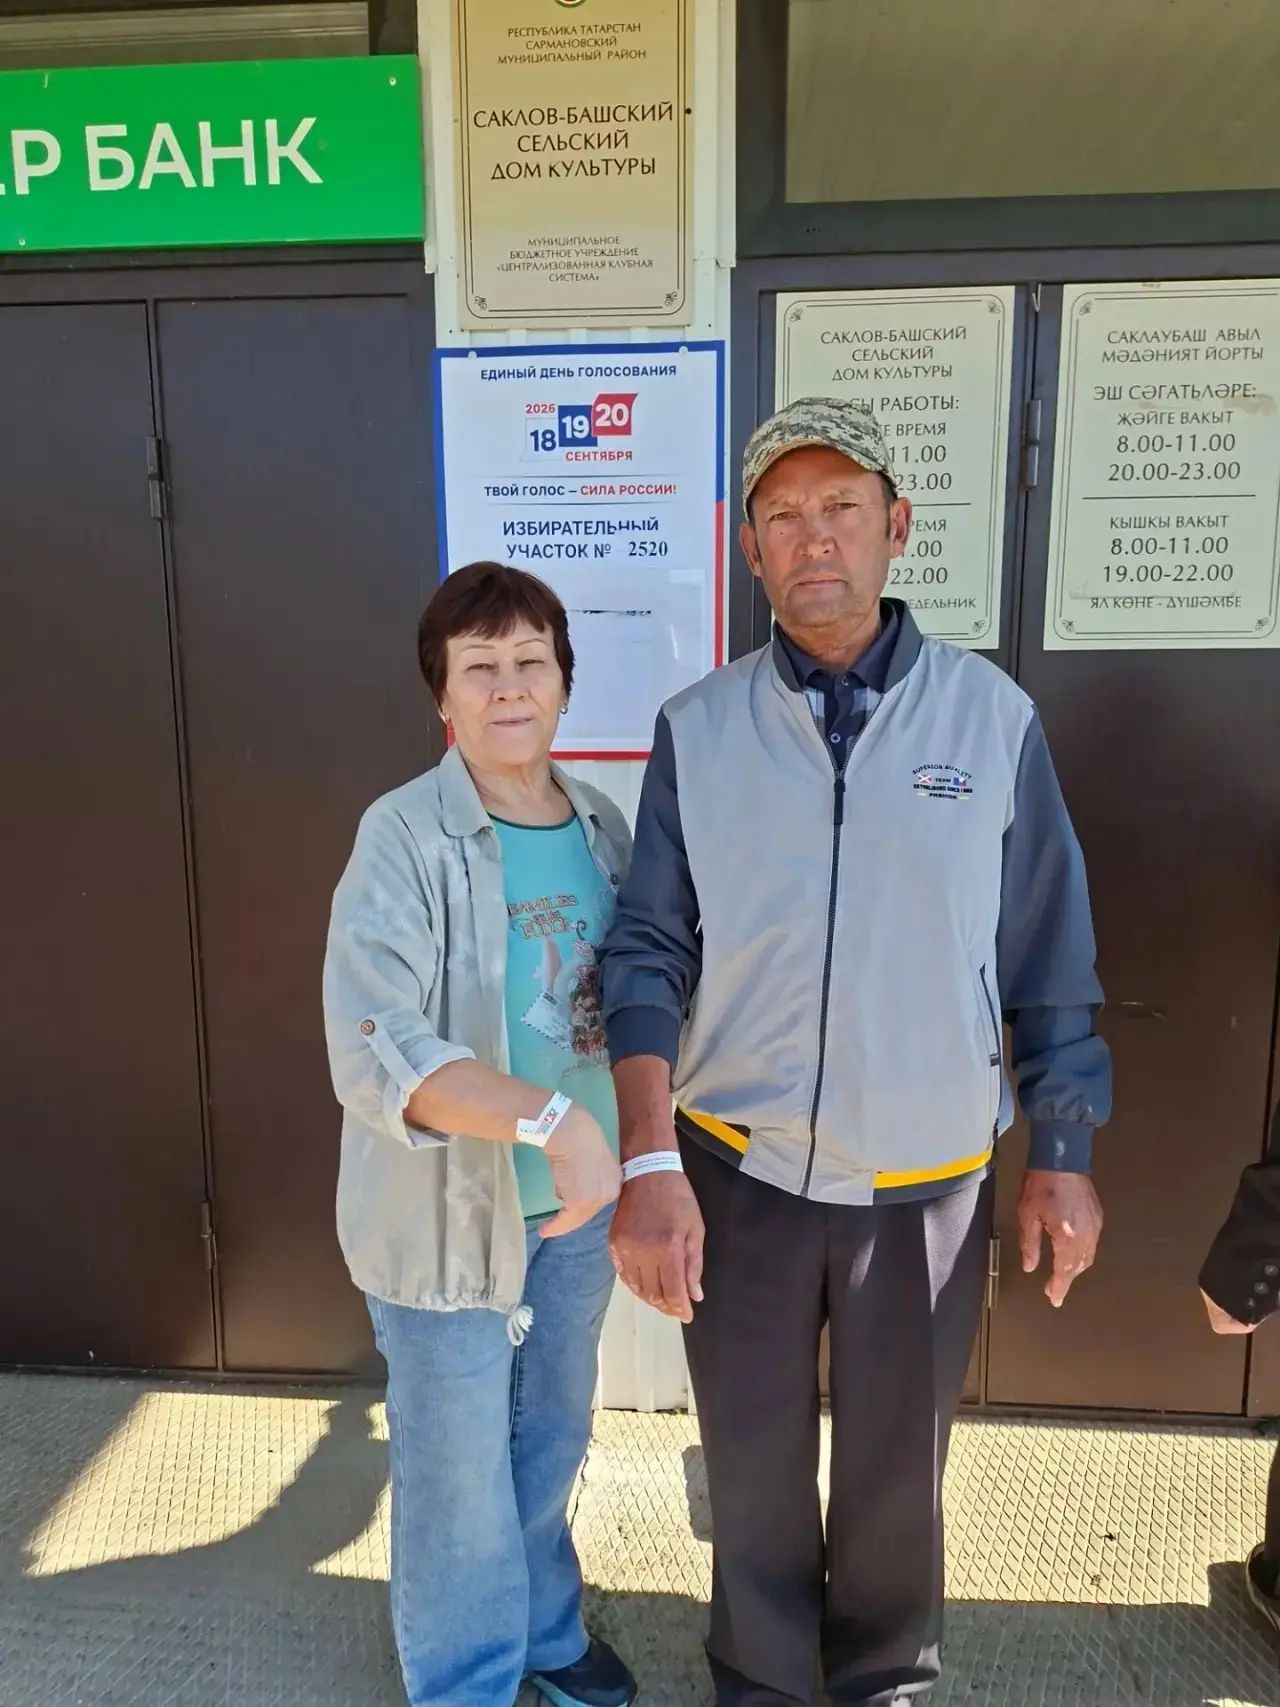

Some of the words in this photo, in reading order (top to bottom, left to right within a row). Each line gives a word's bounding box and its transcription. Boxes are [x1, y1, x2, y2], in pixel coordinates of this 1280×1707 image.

[507, 26, 577, 38] РЕСПУБЛИКА
[580, 23, 641, 34] ТАТАРСТАН
[525, 36, 617, 50] САРМАНОВСКИЙ
[498, 51, 601, 64] МУНИЦИПАЛЬНЫЙ
[607, 49, 646, 60] РАЙОН
[473, 101, 673, 128] САКЛОВ-БАШСКИЙ
[517, 129, 629, 153] СЕЛЬСКИЙ
[0, 129, 62, 195] Р
[85, 117, 324, 192] БАНК
[491, 161, 541, 180] ДОМ
[548, 157, 656, 177] КУЛЬТУРЫ
[528, 236, 620, 247] МУНИЦИПАЛЬНОЕ
[509, 249, 572, 259] БЮДЖЕТНОЕ
[575, 247, 639, 258] УЧРЕЖДЕНИЕ
[497, 260, 605, 272] «ЦЕНТРАЛИЗОВАННАЯ
[608, 259, 653, 269] КЛУБНАЯ
[548, 273, 600, 282] СИСТЕМА»
[820, 326, 967, 345] САКЛОВ-БАШСКИЙ
[1107, 329, 1207, 344] САКЛАУБАШ
[1215, 328, 1261, 341] АВЫЛ
[852, 345, 933, 362] СЕЛЬСКИЙ
[1102, 348, 1200, 364] МӘДӘНИЯТ
[1205, 346, 1263, 361] ЙОРТЫ
[480, 366, 536, 381] ЕДИНЫЙ
[540, 367, 574, 379] ДЕНЬ
[578, 365, 677, 377] ГОЛОСОВАНИЯ
[832, 368, 869, 382] ДОМ
[874, 365, 953, 380] КУЛЬТУРЫ
[1094, 385, 1123, 401] ЭШ
[1129, 383, 1257, 400] СӘГАТЬЛӘРЕ:
[525, 403, 556, 414] 2026
[881, 395, 960, 412] РАБОТЫ:
[595, 403, 629, 427] 20
[1180, 411, 1234, 425] ВАКЫТ
[561, 415, 590, 439] 19
[896, 422, 946, 437] ВРЕМЯ
[530, 429, 557, 452] 18
[1117, 433, 1236, 453] 8.00-11.00
[565, 451, 633, 462] СЕНТЯБРЯ
[889, 445, 947, 463] 11.00
[1108, 461, 1241, 481] 20.00-23.00
[895, 472, 952, 491] 23.00
[484, 484, 519, 497] ТВОЙ
[522, 485, 565, 496] ГОЛОС
[580, 484, 615, 496] СИЛА
[619, 484, 677, 495] РОССИИ!
[503, 516, 660, 536] ИЗБИРАТЕЛЬНЫЙ
[911, 519, 947, 532] ЕМЯ
[1110, 516, 1170, 529] КЫШКЫ
[1175, 515, 1230, 528] ВАКЫТ
[507, 544, 589, 559] УЧАСТОК
[594, 544, 611, 558] №
[628, 541, 668, 557] 2520
[1111, 536, 1229, 555] 8.00-11.00
[890, 567, 948, 585] 22.00
[1104, 564, 1234, 583] 19.00-22.00
[906, 598, 977, 610] ЕДЕЛЬНИК
[1090, 597, 1109, 609] ЯЛ
[1113, 596, 1154, 609] КӨНЕ
